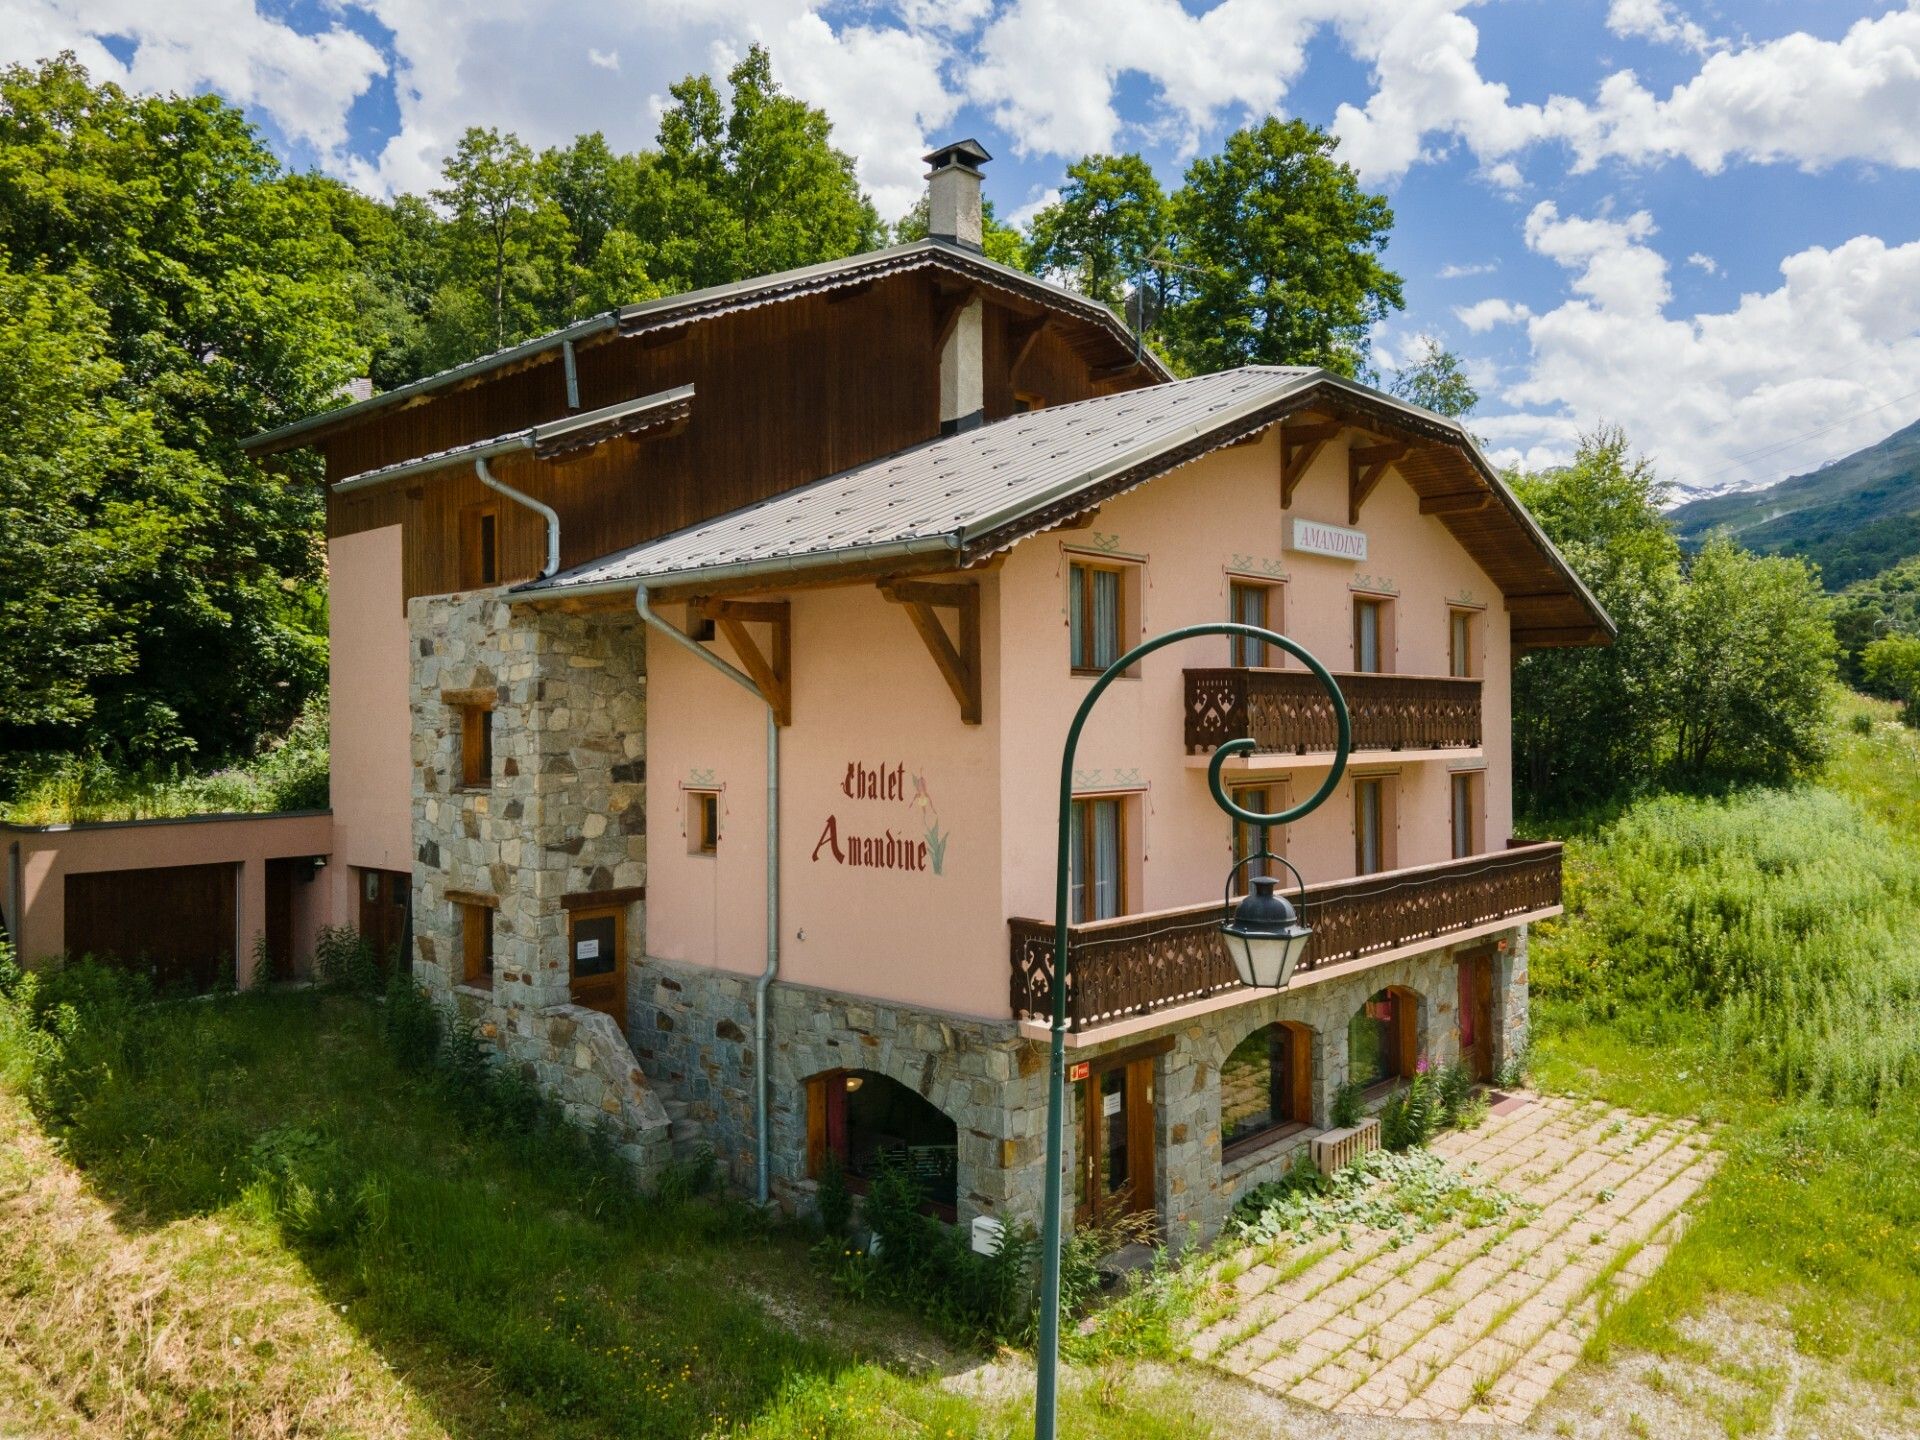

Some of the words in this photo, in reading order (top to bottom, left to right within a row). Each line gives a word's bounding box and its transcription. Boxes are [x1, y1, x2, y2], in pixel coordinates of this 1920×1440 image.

[1300, 526, 1364, 556] AMANDINE
[841, 760, 905, 801] Chalet
[812, 814, 927, 871] Amandine
